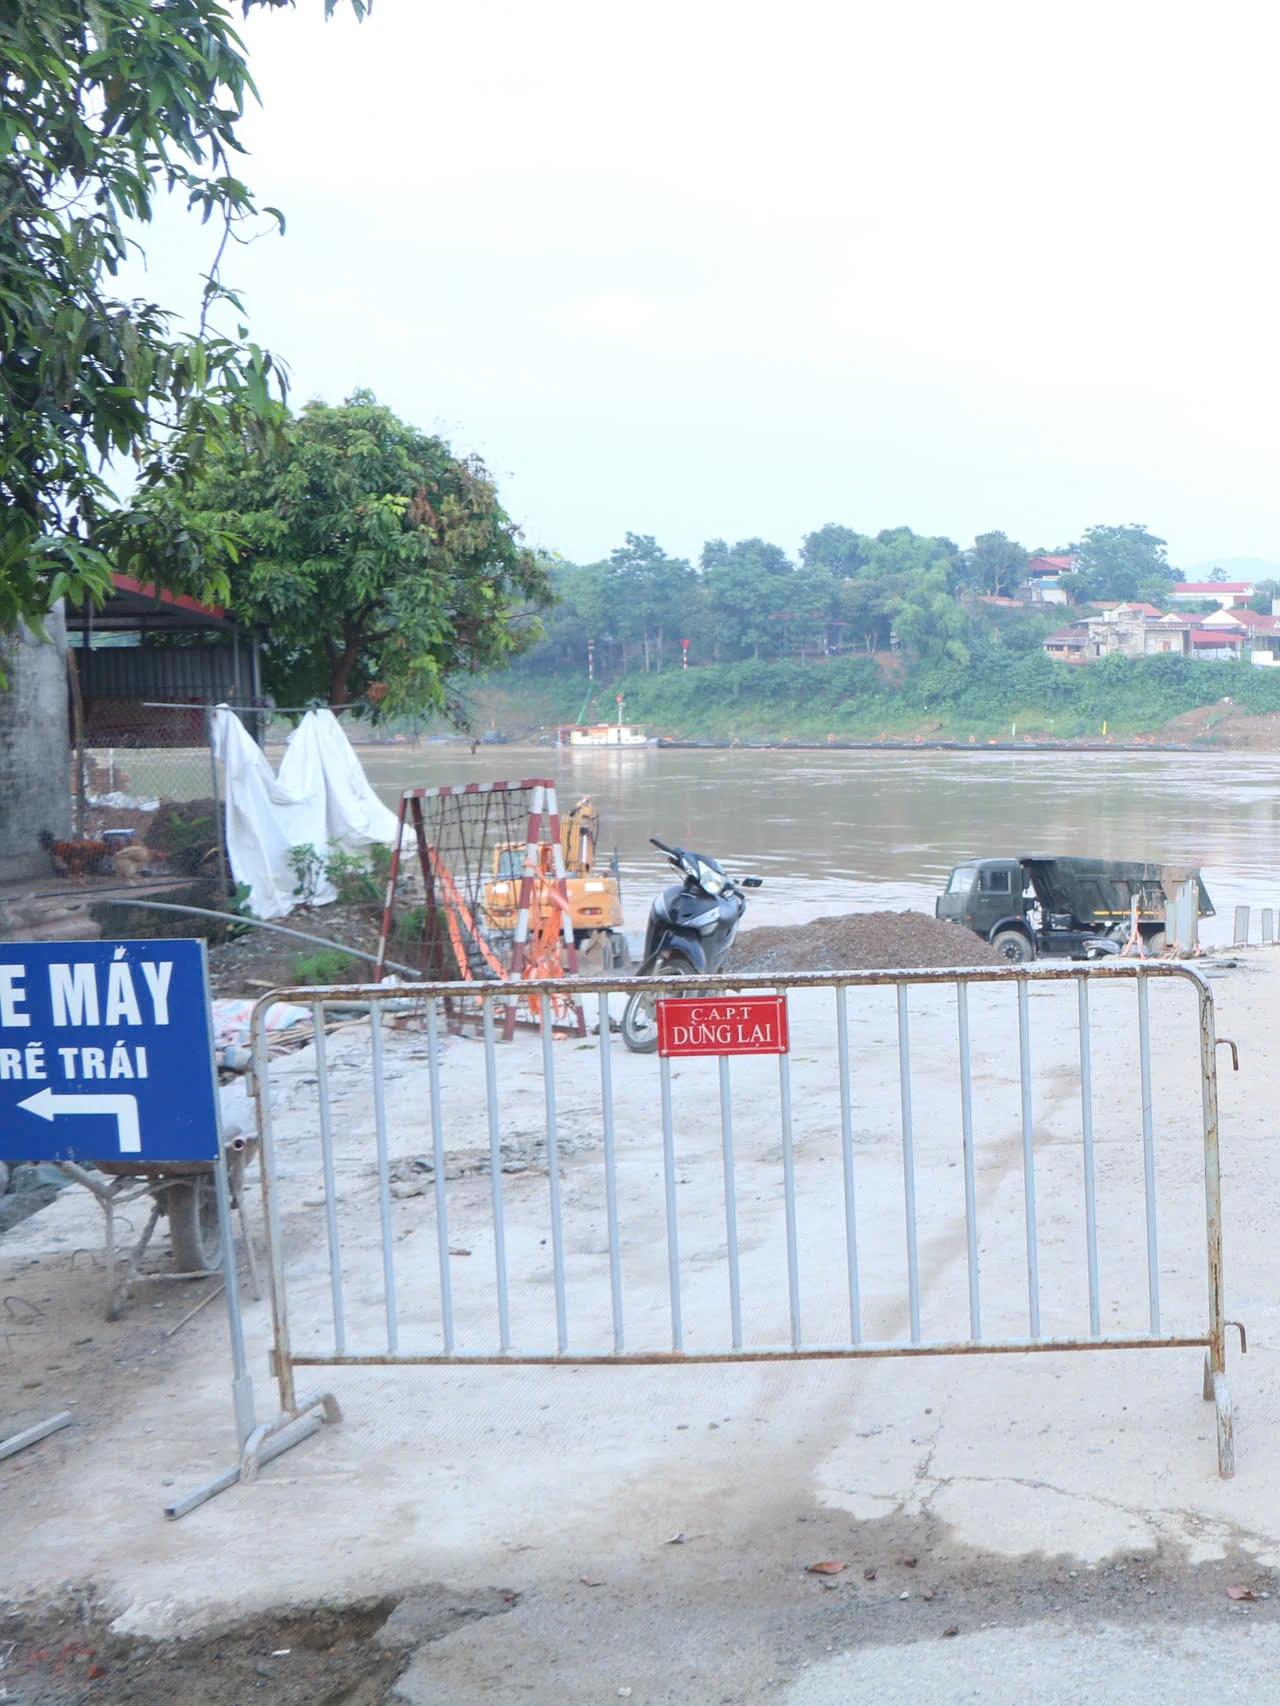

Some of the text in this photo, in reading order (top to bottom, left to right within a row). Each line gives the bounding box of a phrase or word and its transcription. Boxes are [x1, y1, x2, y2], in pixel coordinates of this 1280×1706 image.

[48, 944, 173, 1027] MÁY
[691, 1007, 751, 1020] C.A.P.T
[737, 1023, 773, 1048] LẠI
[0, 1039, 148, 1080] RẼ TRÁI
